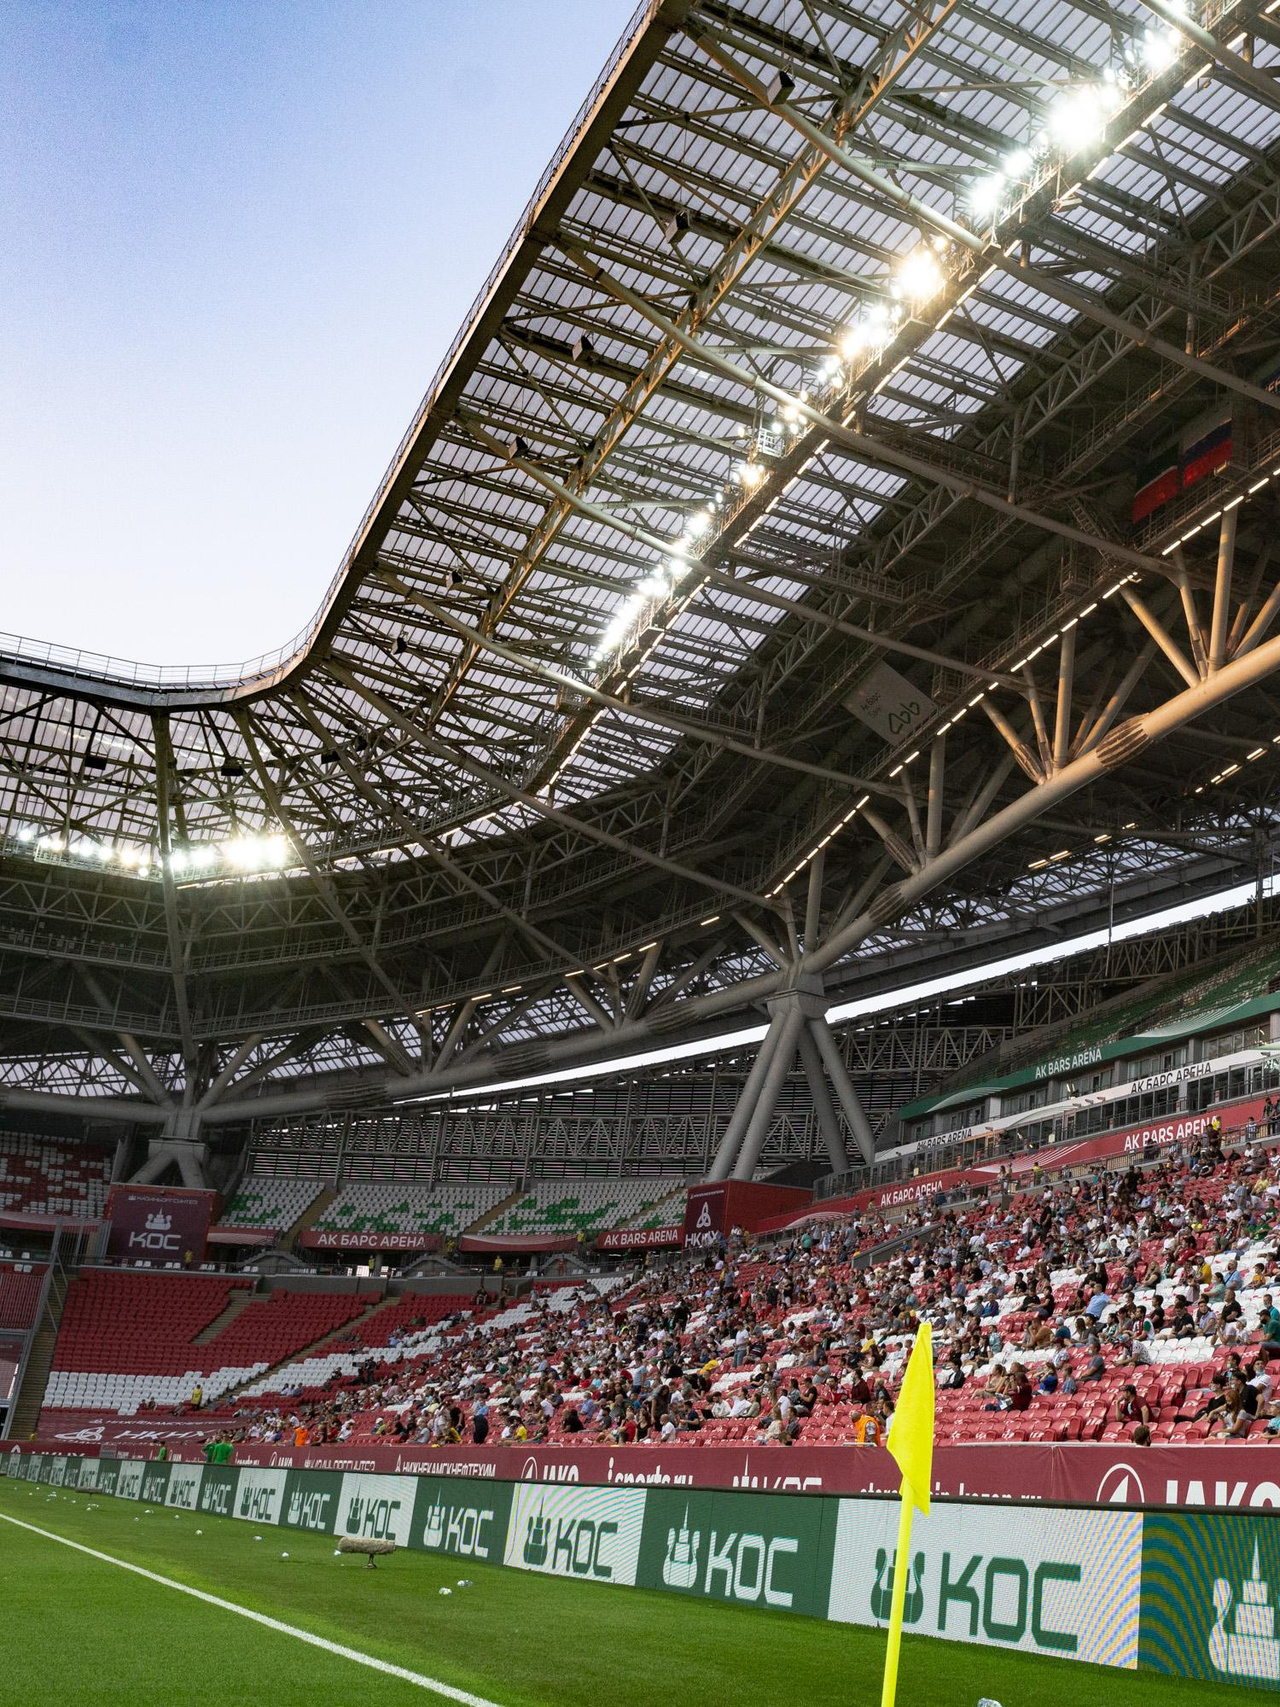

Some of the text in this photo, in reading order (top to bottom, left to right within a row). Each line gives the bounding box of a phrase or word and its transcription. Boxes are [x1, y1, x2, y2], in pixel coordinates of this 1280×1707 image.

[1035, 1048, 1102, 1079] AK BARS ARENA
[1130, 1080, 1145, 1094] АК
[1146, 1072, 1174, 1090] БАРС
[1123, 1130, 1140, 1151] AK
[880, 1194, 892, 1207] АК
[893, 1187, 914, 1204] БАРС
[317, 1233, 426, 1249] АК БАРС АРЕНА
[604, 1227, 677, 1247] AK BARS ARENA
